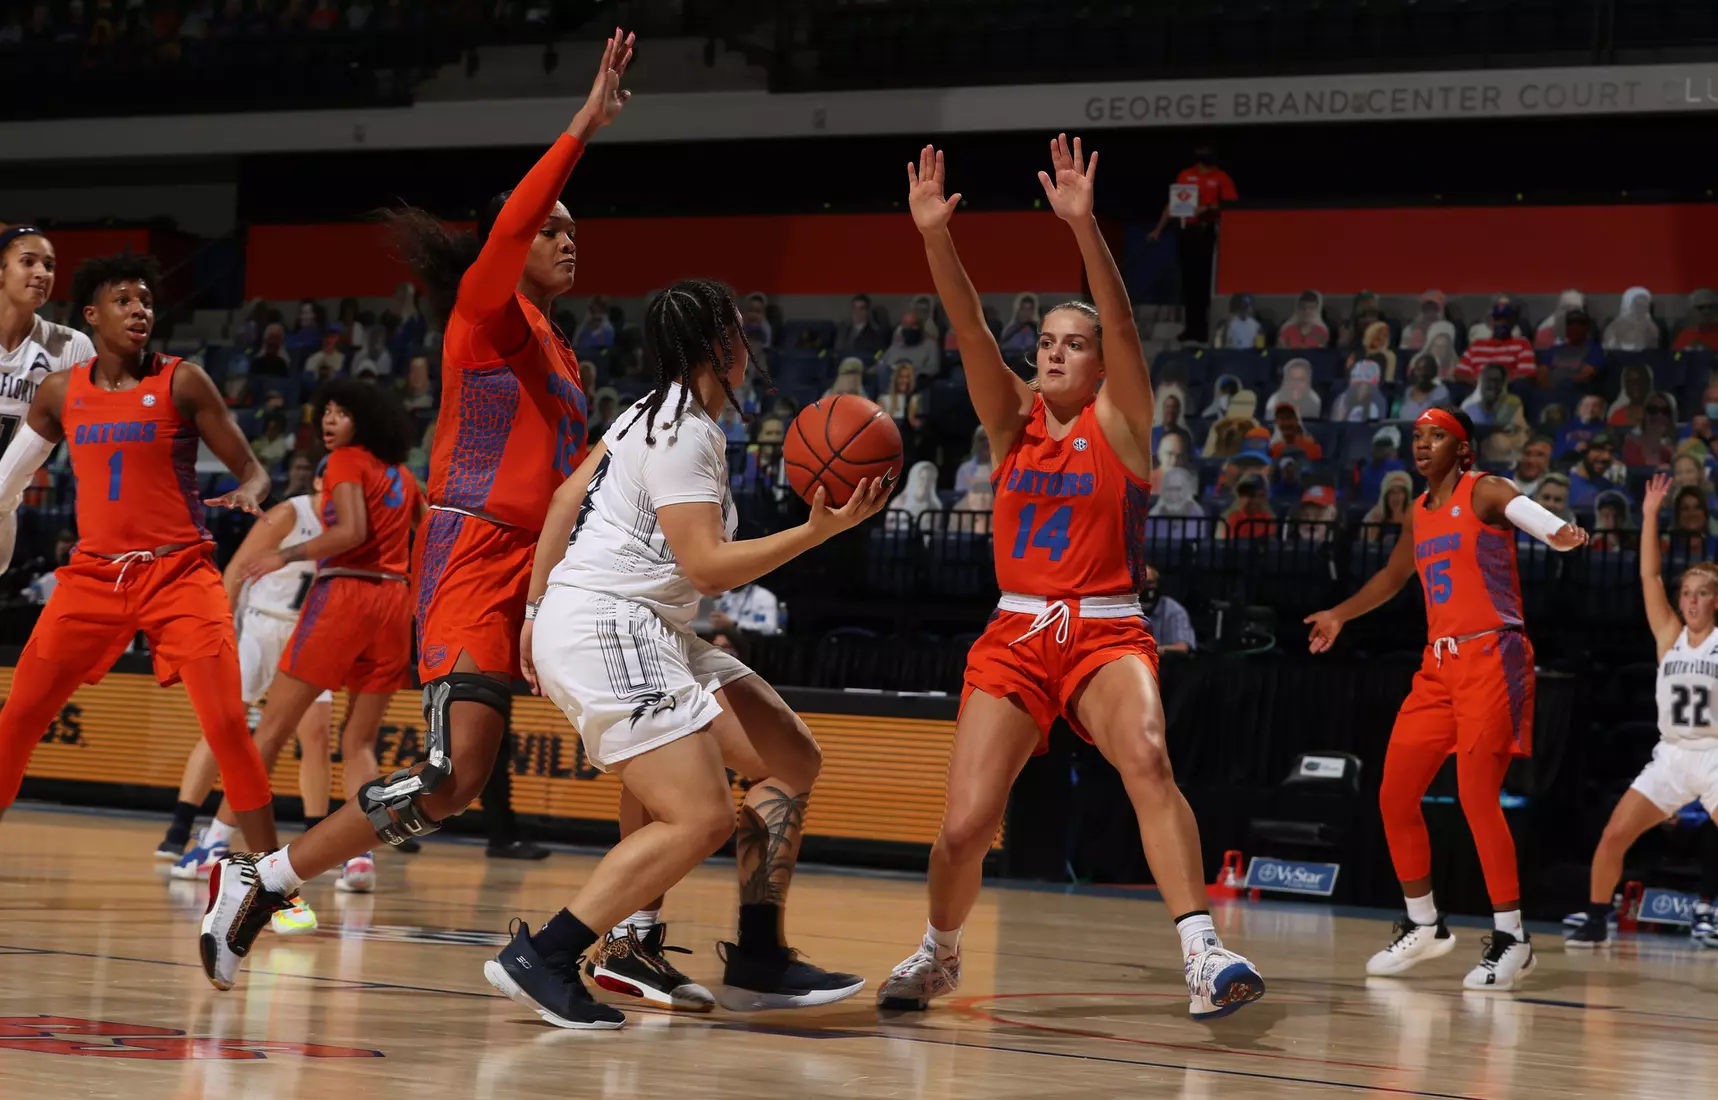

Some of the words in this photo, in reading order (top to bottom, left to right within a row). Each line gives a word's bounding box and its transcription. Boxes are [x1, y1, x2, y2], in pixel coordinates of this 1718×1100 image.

[1085, 93, 1218, 121] GEORGE
[1233, 89, 1349, 118] BRAND
[1366, 85, 1502, 114] CENTER
[1518, 80, 1642, 110] COURT
[75, 421, 158, 445] GATORS
[108, 450, 124, 501] 1
[1007, 468, 1095, 497] GATORS
[1012, 502, 1073, 561] 14
[1415, 533, 1462, 561] GATORS
[1425, 559, 1452, 608] 15
[1671, 684, 1711, 727] 22
[1277, 865, 1326, 886] VyStar
